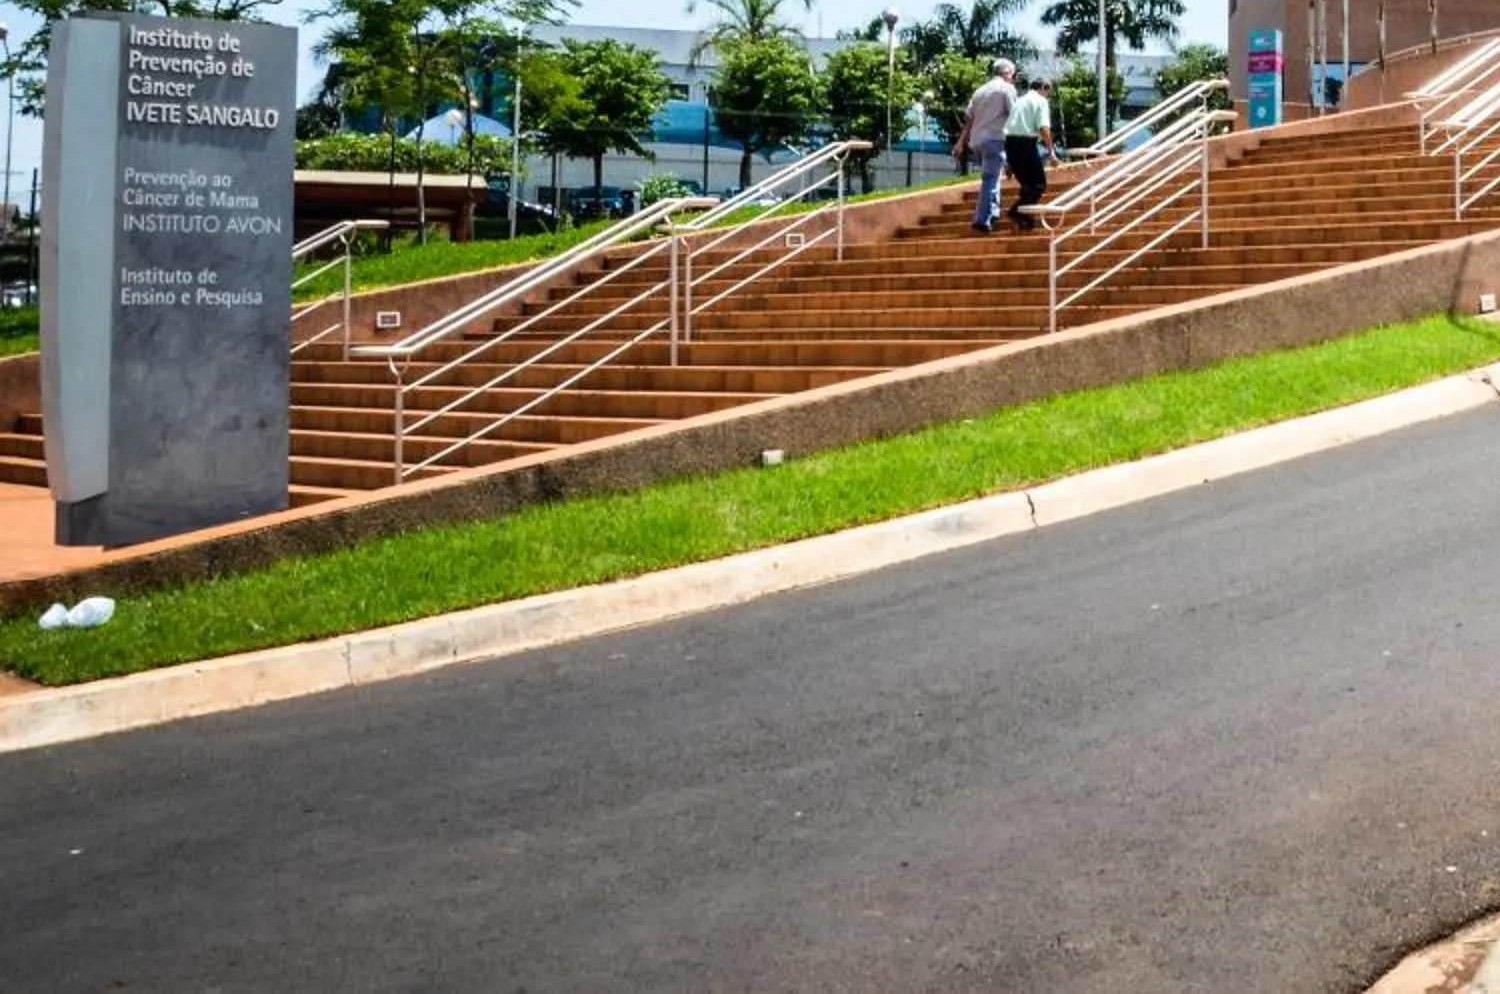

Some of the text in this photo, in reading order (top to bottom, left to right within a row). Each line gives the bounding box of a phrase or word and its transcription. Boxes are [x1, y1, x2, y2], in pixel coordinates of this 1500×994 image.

[129, 24, 241, 53] Instituto de
[129, 49, 255, 79] Prevenção de
[127, 74, 196, 97] Câncer
[127, 101, 279, 129] IVETE SANGALO
[124, 167, 232, 191] Prevenção ao
[123, 188, 259, 208] Câncer de Mama
[123, 213, 282, 235] INSTITUTO AVON
[121, 267, 218, 285] Instituto de
[121, 286, 263, 309] Ensino e Pesquisa
